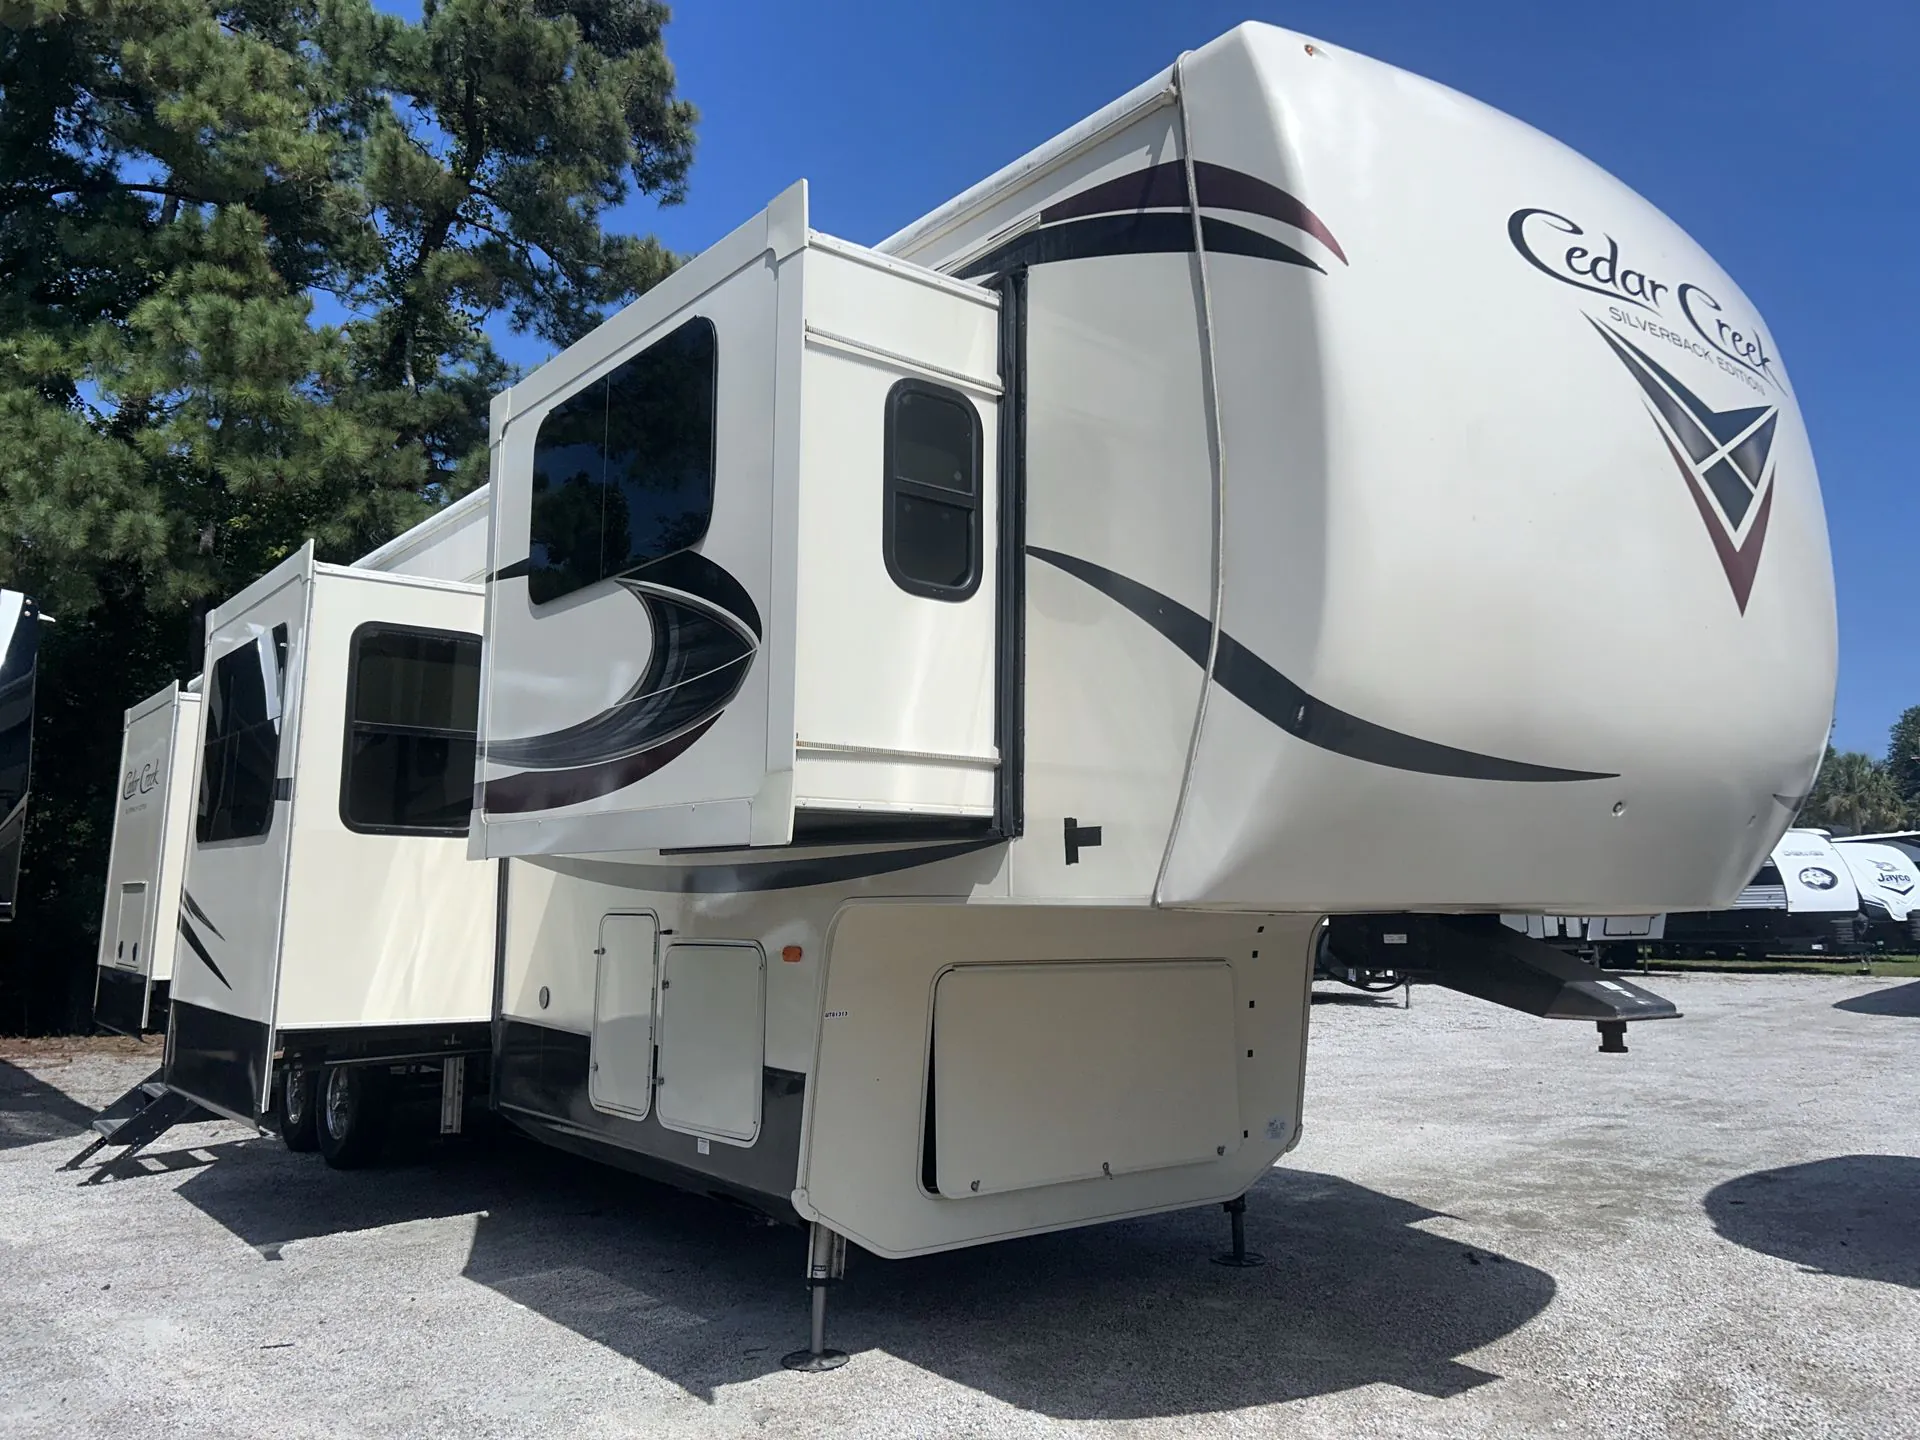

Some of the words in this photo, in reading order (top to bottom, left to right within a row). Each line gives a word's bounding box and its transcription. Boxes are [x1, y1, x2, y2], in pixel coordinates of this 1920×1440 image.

[1507, 208, 1668, 318] Cedar
[1677, 282, 1789, 398] Creek
[1608, 306, 1714, 364] SILVERBACK
[1716, 356, 1767, 396] EDITION
[1877, 872, 1911, 883] Jayco
